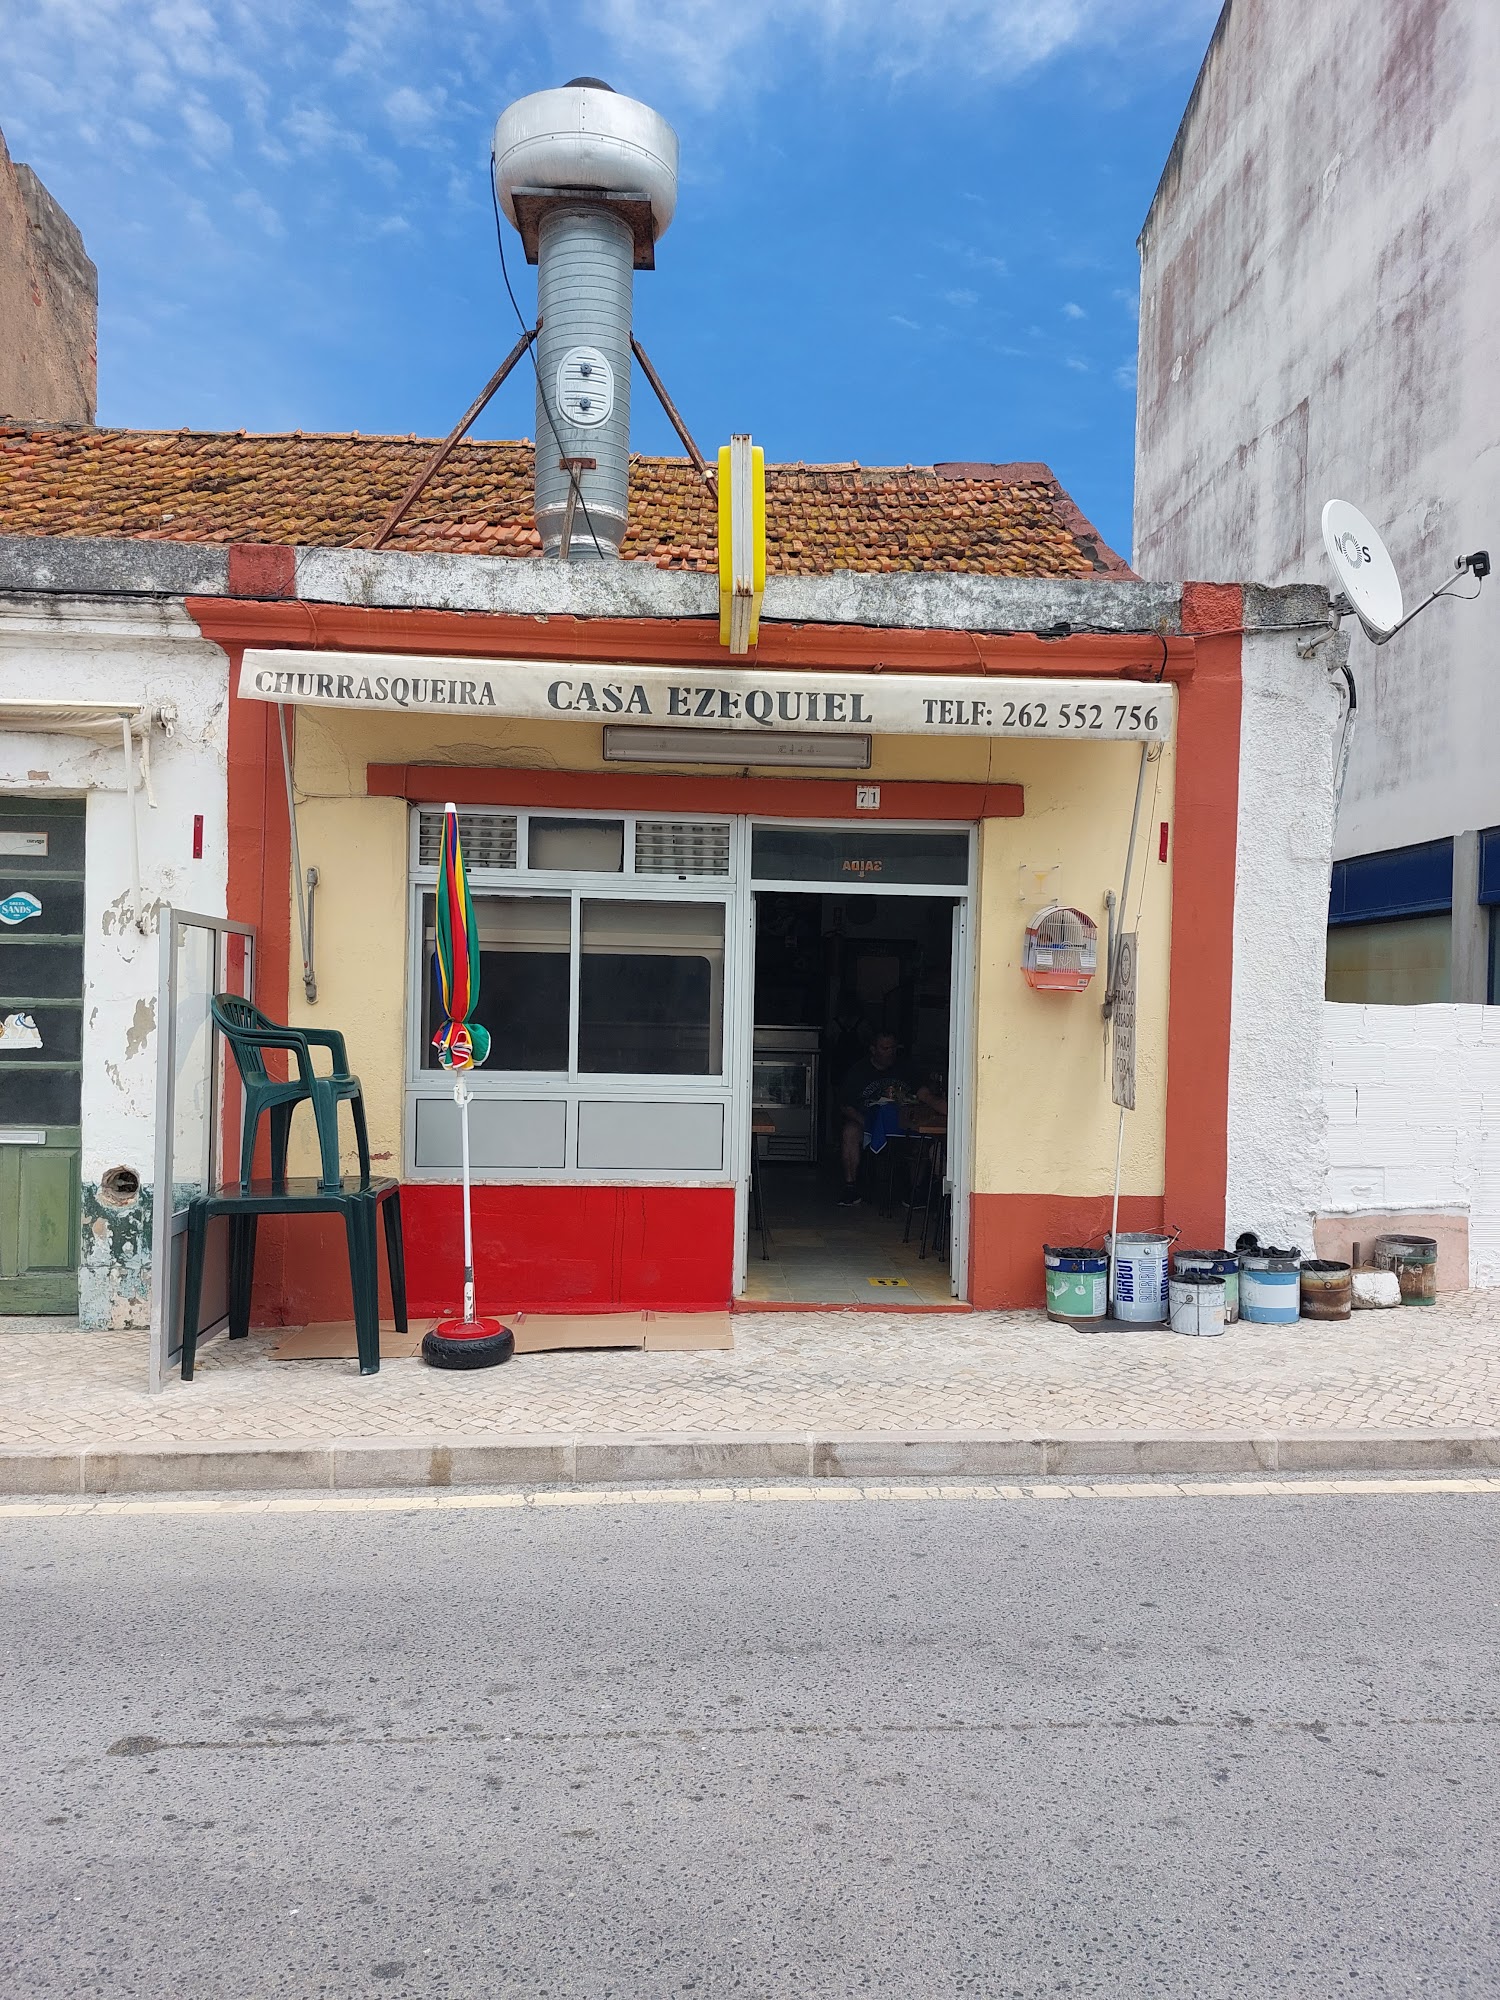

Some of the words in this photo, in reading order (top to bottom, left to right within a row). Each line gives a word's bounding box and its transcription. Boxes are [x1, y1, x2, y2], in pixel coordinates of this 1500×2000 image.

[254, 670, 497, 707] CHURRASQUEIRA
[547, 680, 653, 715] CASA
[667, 687, 873, 727] EZEQUIEL
[922, 699, 993, 727] TELF:
[1002, 702, 1049, 729] 262
[1058, 703, 1103, 730] 552
[1114, 705, 1159, 732] 756
[859, 791, 877, 804] 71
[1, 904, 32, 914] SANDS
